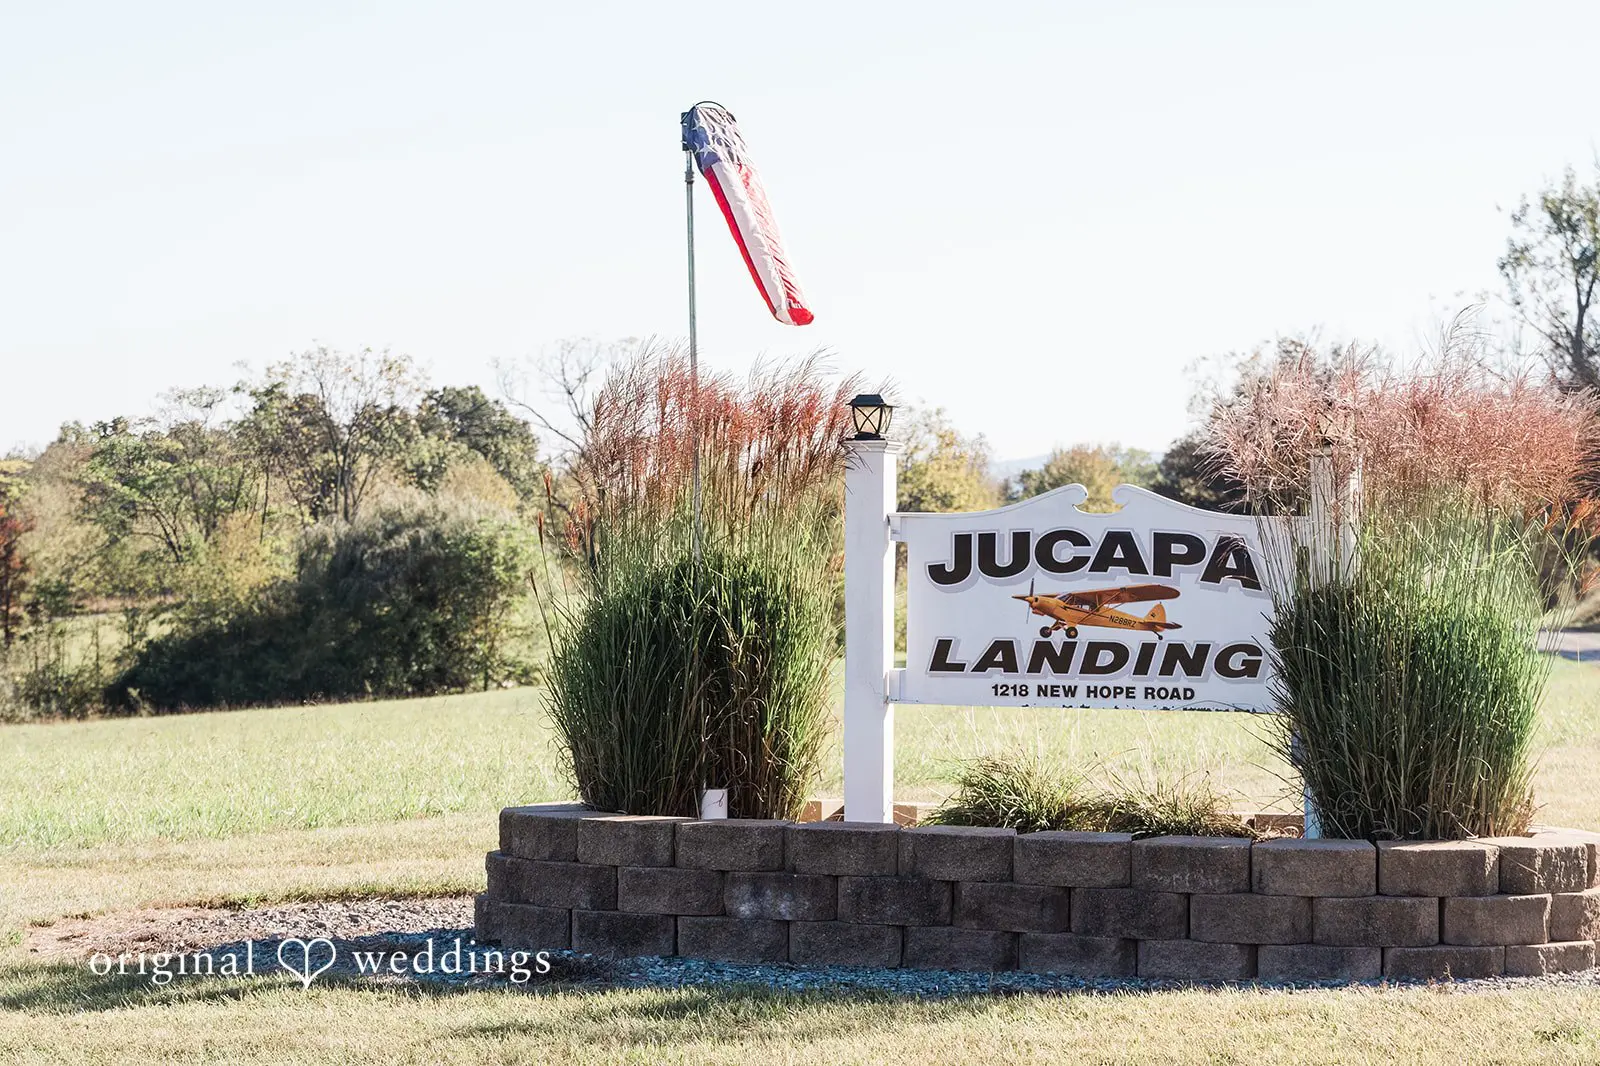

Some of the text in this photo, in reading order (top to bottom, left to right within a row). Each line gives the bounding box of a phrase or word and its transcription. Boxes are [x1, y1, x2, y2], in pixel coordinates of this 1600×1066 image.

[927, 529, 1263, 592] JUCAPA
[929, 639, 1263, 679] LANDING
[991, 683, 1196, 701] 1218 NEW HOPE ROAD
